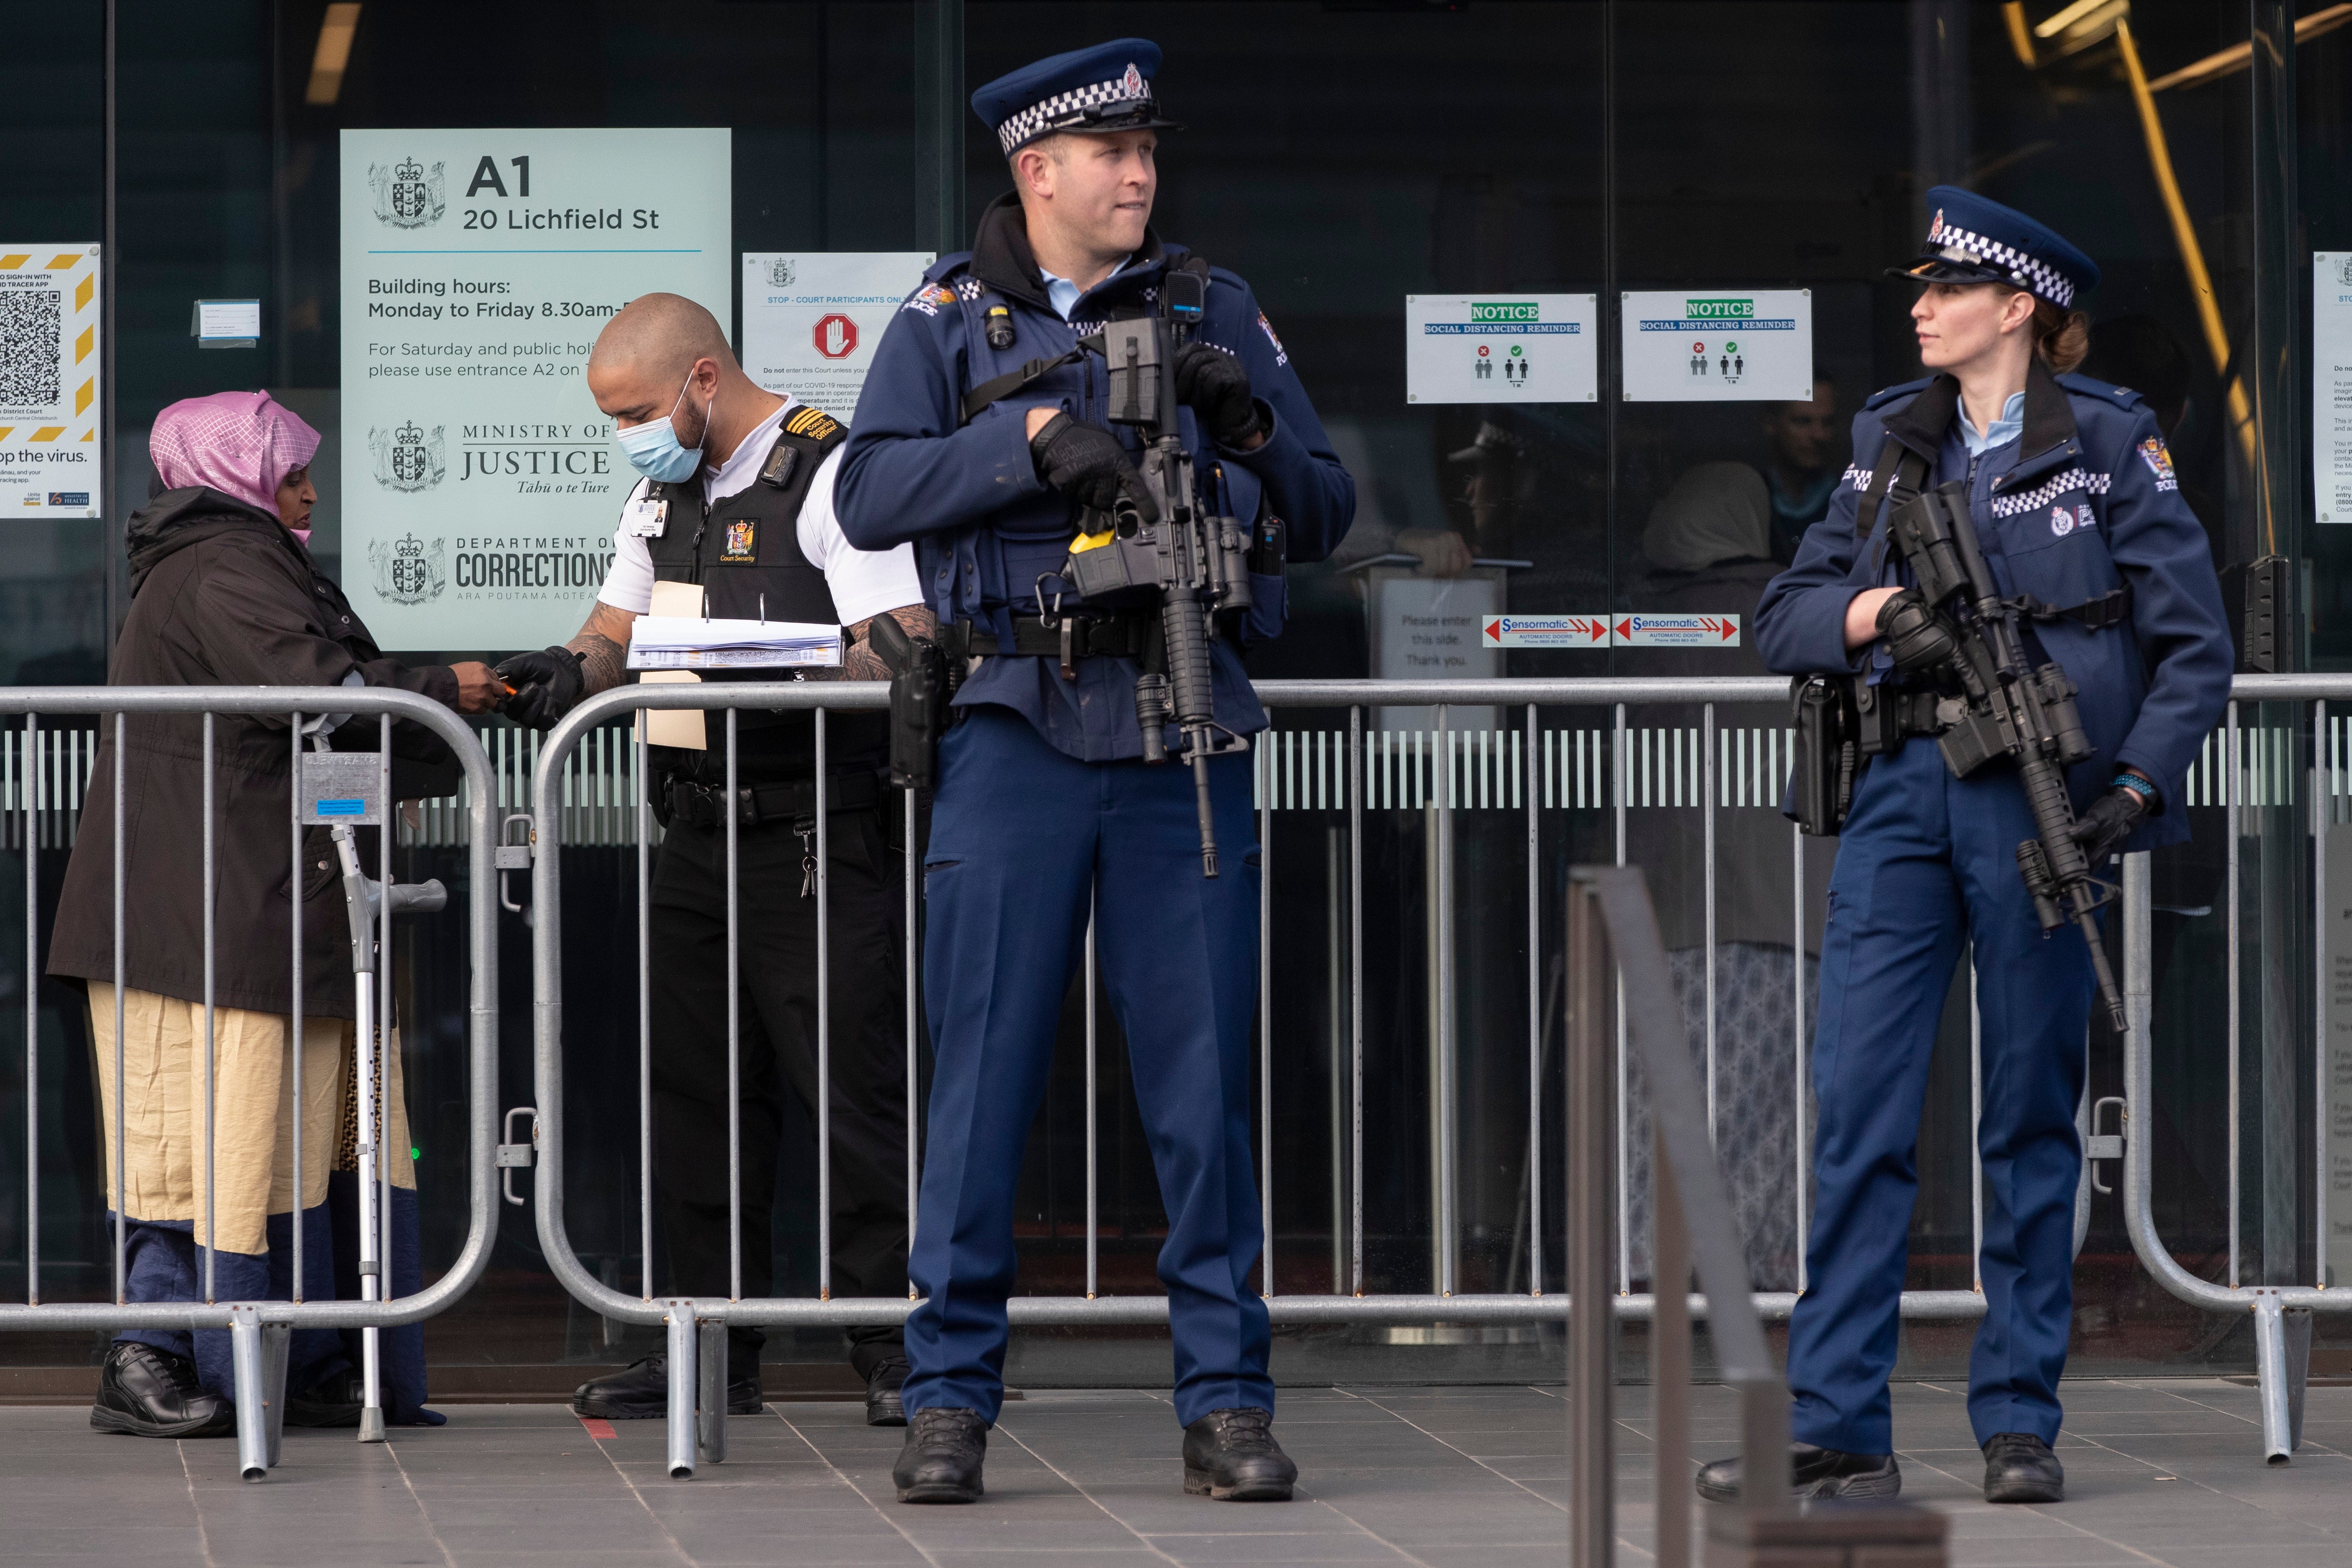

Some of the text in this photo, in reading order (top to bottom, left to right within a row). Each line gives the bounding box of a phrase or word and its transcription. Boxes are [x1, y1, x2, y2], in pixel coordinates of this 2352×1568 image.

[466, 156, 529, 197] A1
[464, 209, 658, 229] 20 Lichfield St
[369, 279, 510, 297] Building hours:
[369, 303, 443, 320] Monday
[450, 304, 469, 317] to
[477, 302, 534, 320] Friday
[1472, 307, 1538, 318] NOTICE
[1687, 303, 1753, 315] NOTICE
[370, 343, 395, 355] For
[402, 343, 472, 357] Saturday
[478, 342, 506, 355] and
[514, 342, 561, 357] public
[369, 364, 579, 378] please use entrance A2 on
[463, 425, 609, 437] MINISTRY OF
[807, 418, 826, 431] Court
[808, 419, 835, 437] Security
[816, 424, 837, 440] Officer
[18, 449, 43, 462] the
[47, 449, 87, 462] virus.
[460, 451, 610, 482] JUSTICE
[518, 481, 550, 492] Tāhū
[567, 484, 578, 492] te
[582, 481, 609, 492] Ture
[458, 537, 586, 548] DEPARTMENT
[1402, 615, 1472, 627] Please enter
[1502, 619, 1568, 632] Sensormatic
[1633, 617, 1698, 630] Sensormatic
[1412, 635, 1462, 645] this side.
[1406, 654, 1440, 665] Thank
